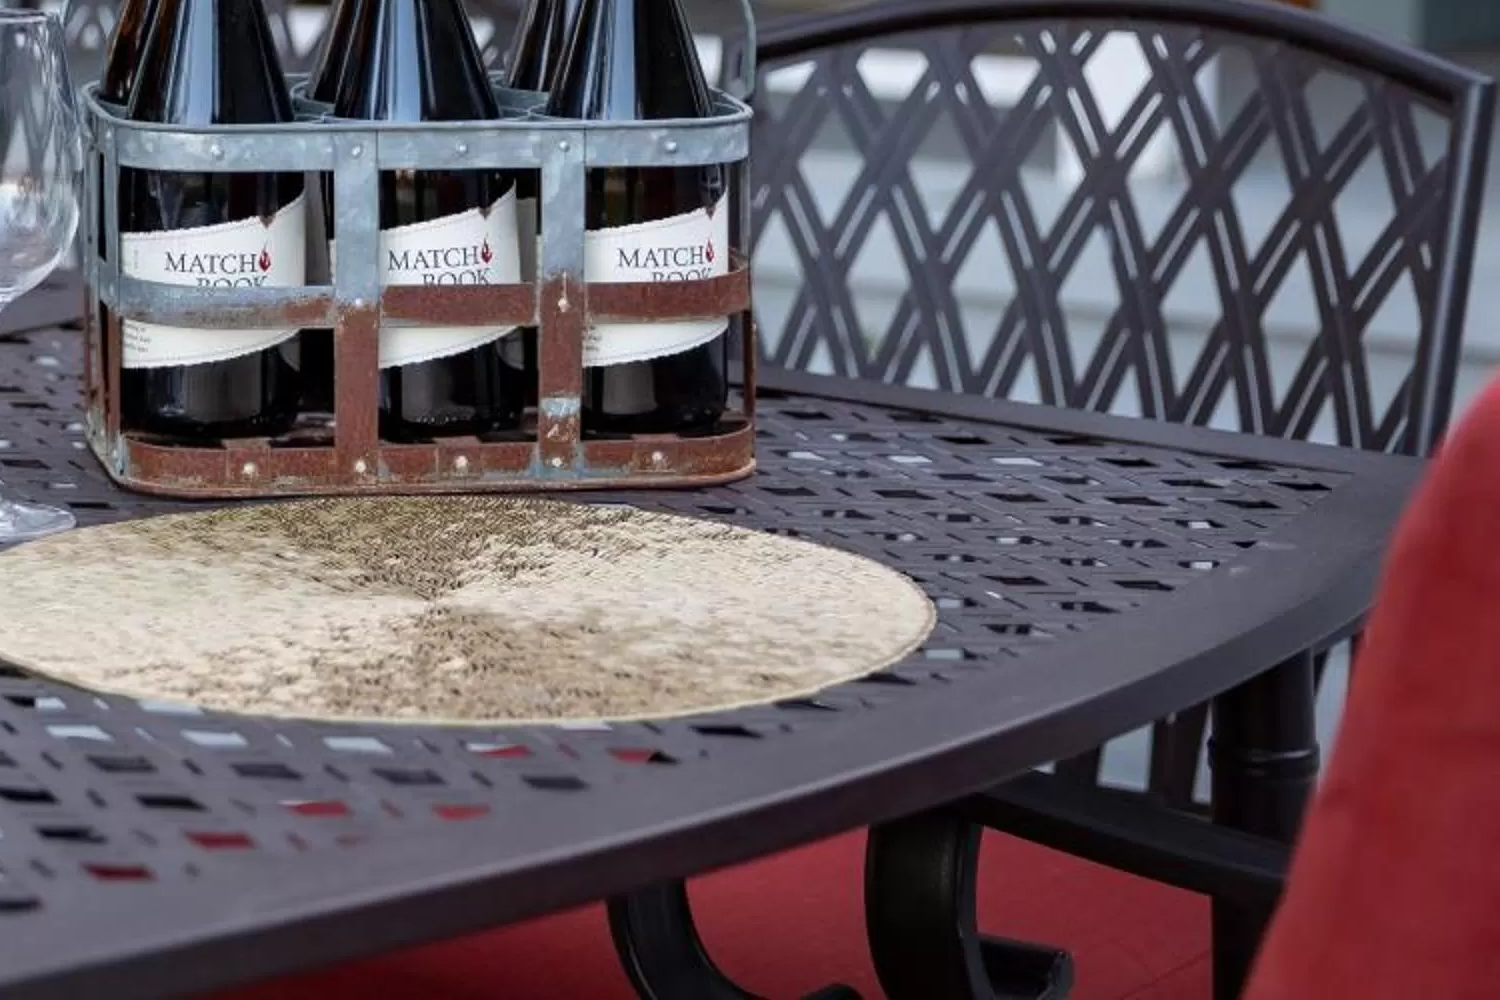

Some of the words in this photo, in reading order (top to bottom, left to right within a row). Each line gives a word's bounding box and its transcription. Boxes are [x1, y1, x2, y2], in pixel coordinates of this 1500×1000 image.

[164, 251, 258, 274] MATCH
[388, 245, 479, 271] MATCH
[617, 245, 704, 268] MATCH
